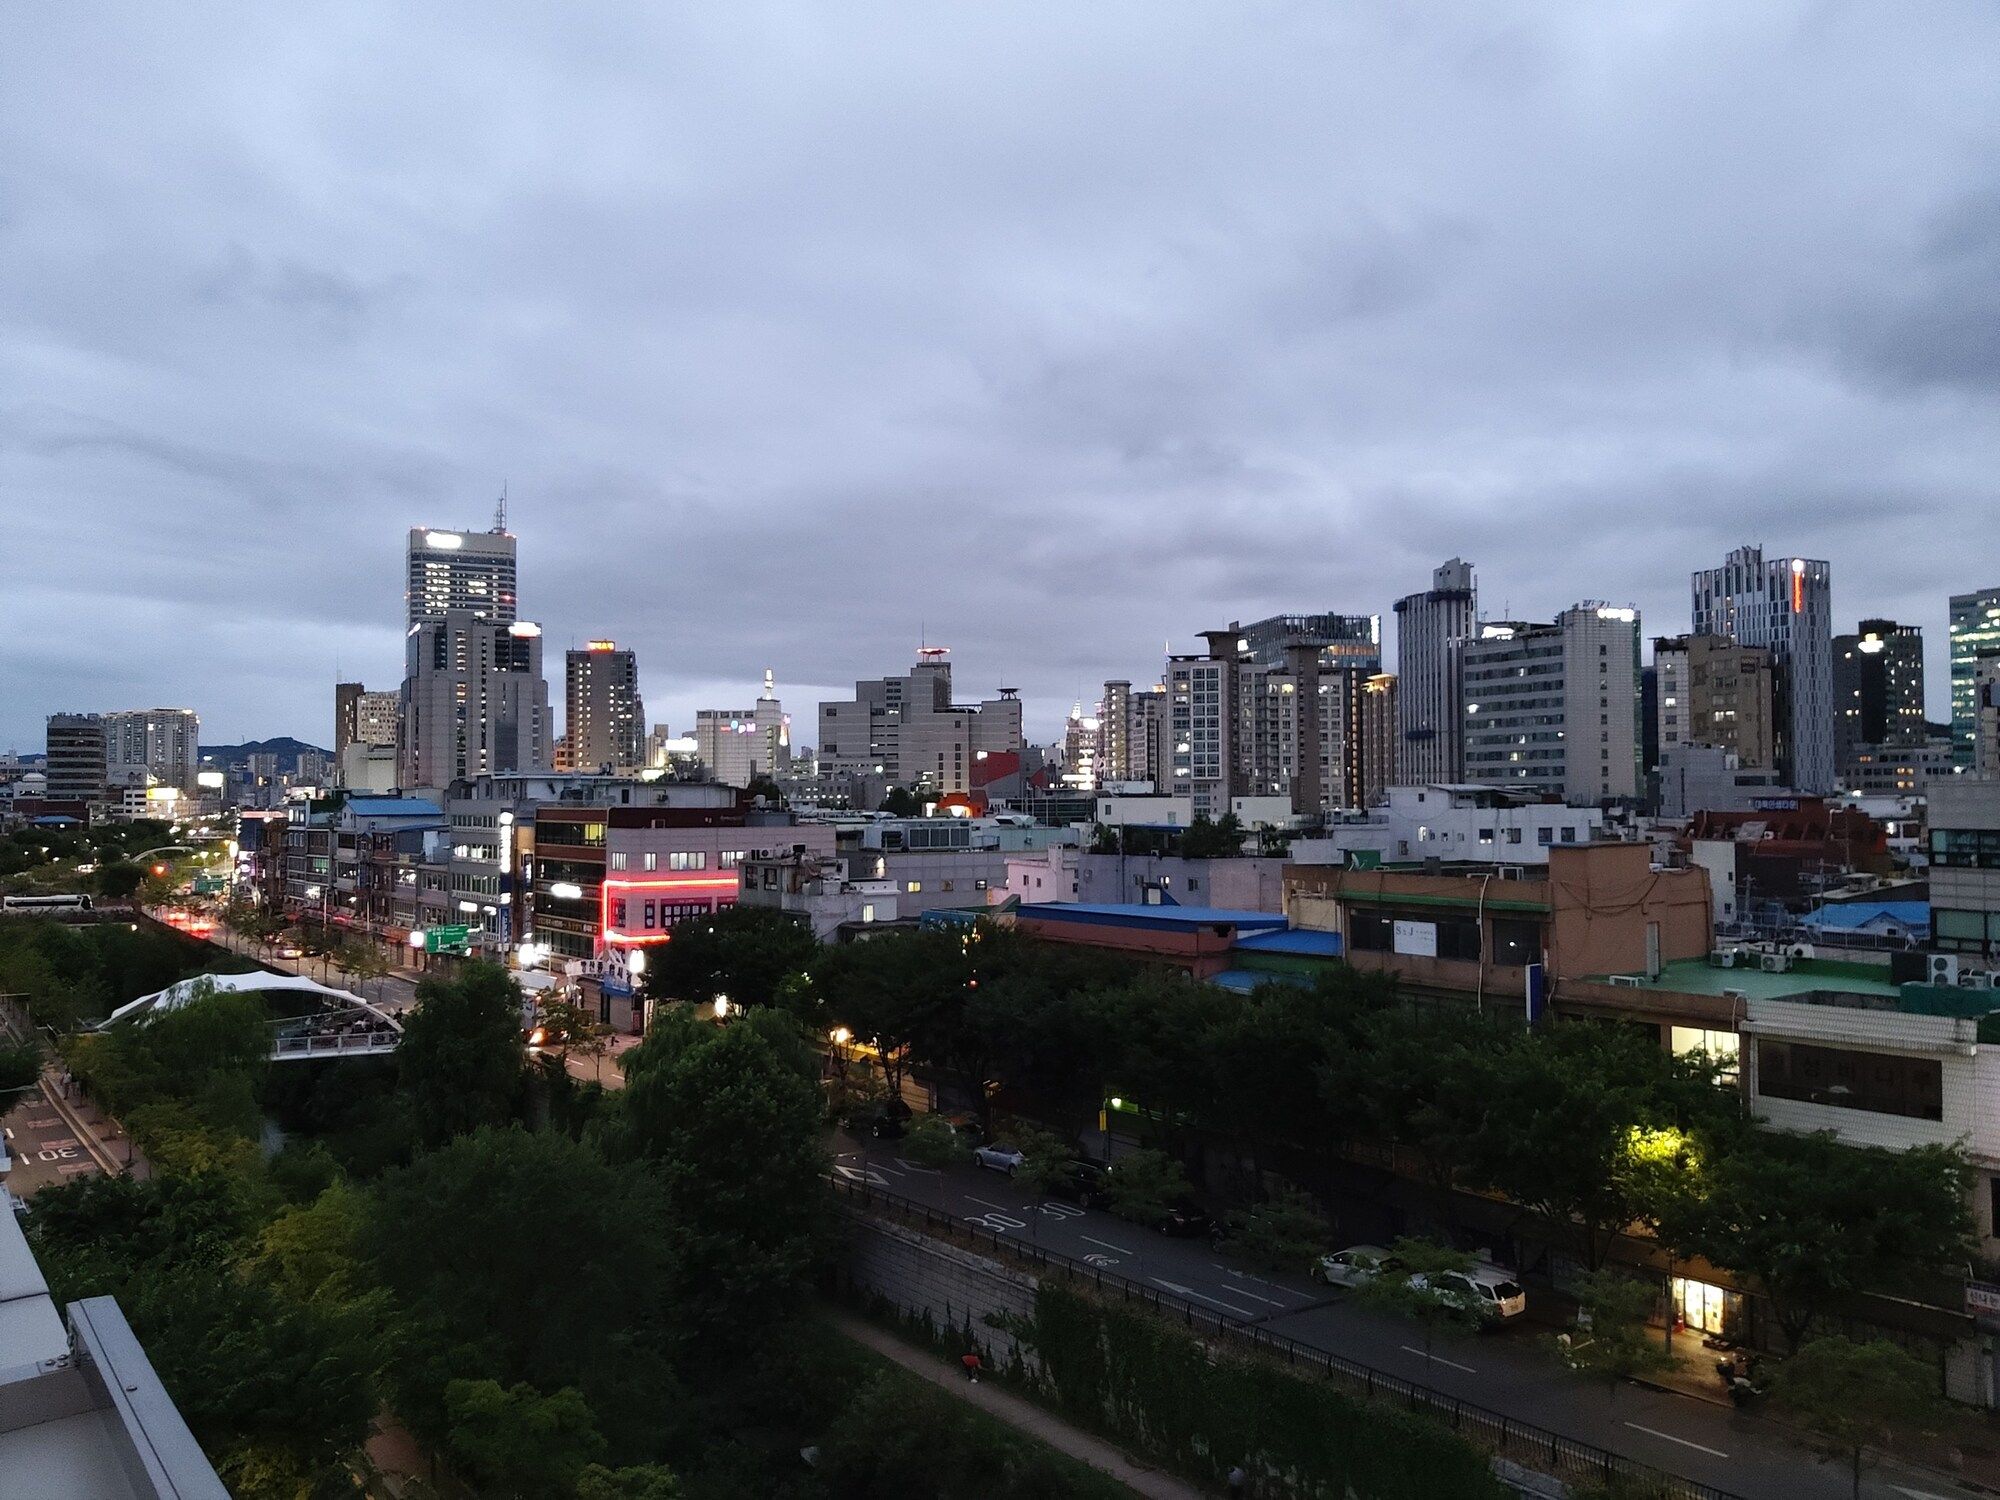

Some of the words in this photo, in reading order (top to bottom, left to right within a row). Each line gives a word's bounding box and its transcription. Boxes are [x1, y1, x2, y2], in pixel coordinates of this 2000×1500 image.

[38, 1147, 79, 1161] 30
[1022, 1202, 1087, 1221] 30
[963, 1213, 1028, 1233] 30
